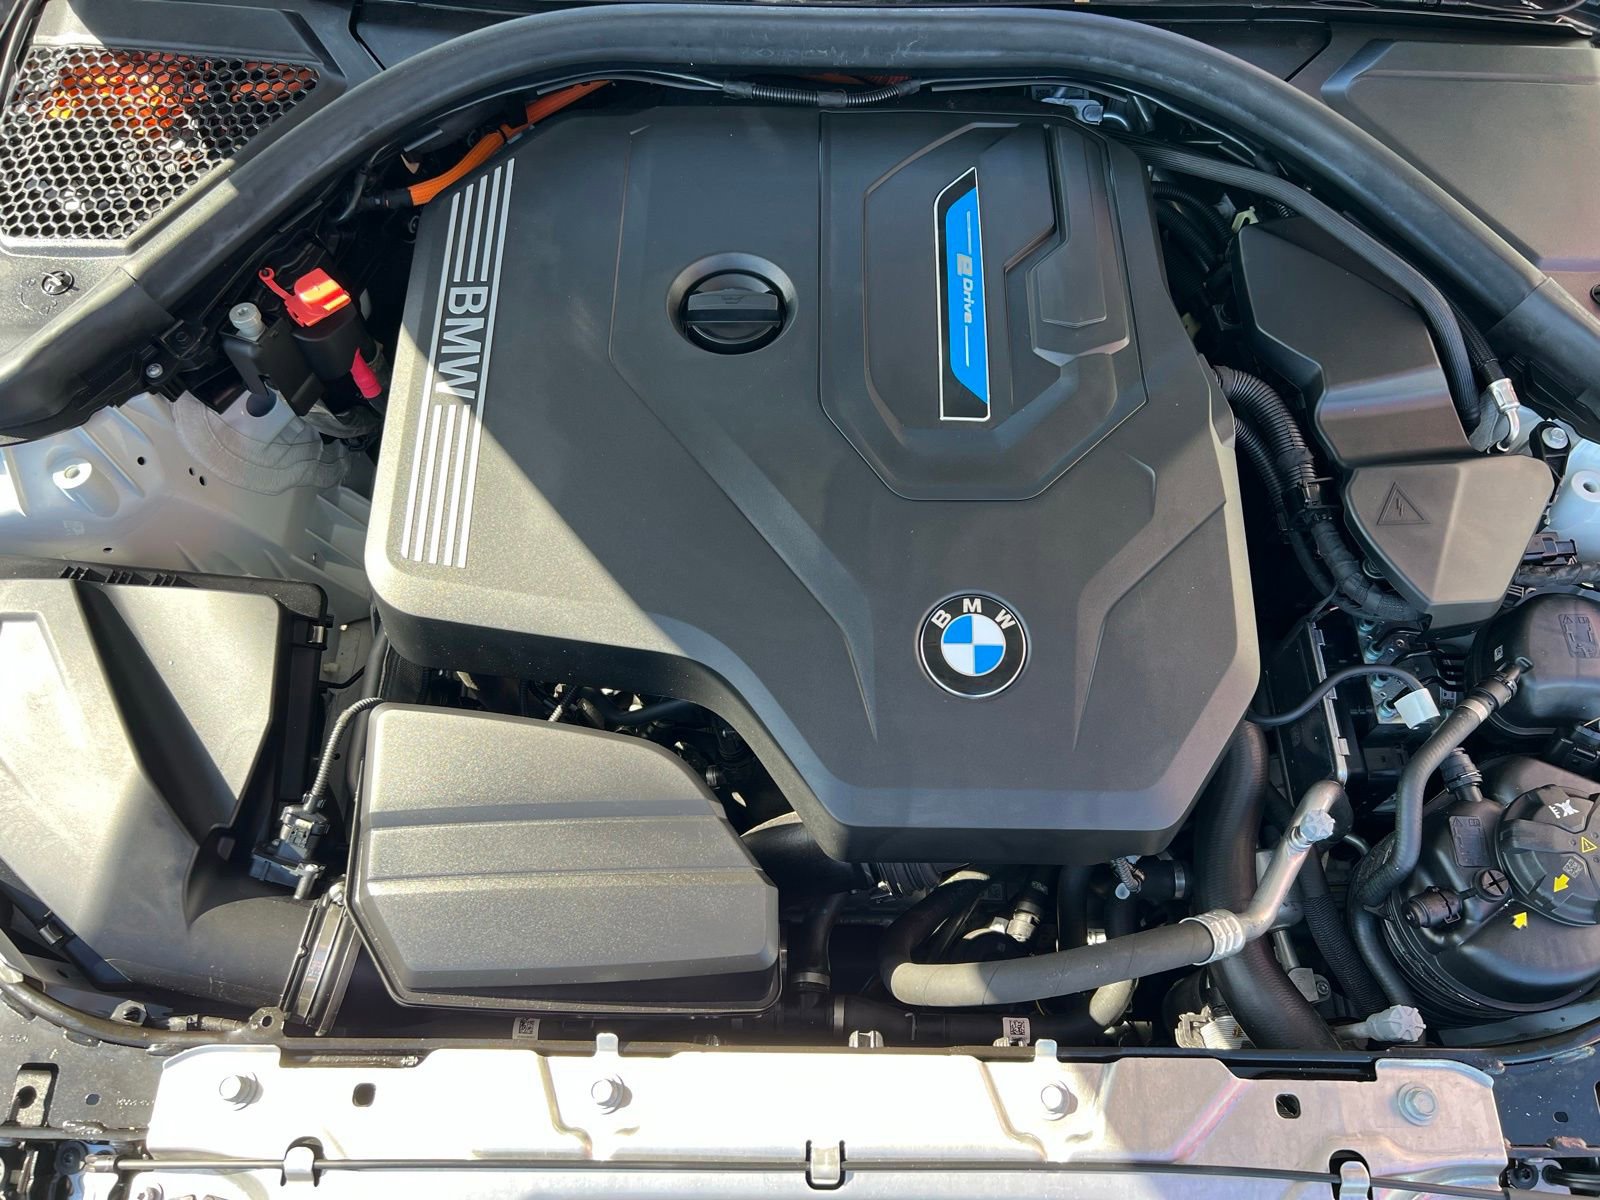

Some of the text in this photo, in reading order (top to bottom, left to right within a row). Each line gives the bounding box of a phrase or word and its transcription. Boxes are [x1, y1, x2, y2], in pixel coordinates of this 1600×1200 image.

[956, 253, 975, 324] eDrive
[435, 286, 489, 399] BMW
[931, 598, 1016, 629] BMW
